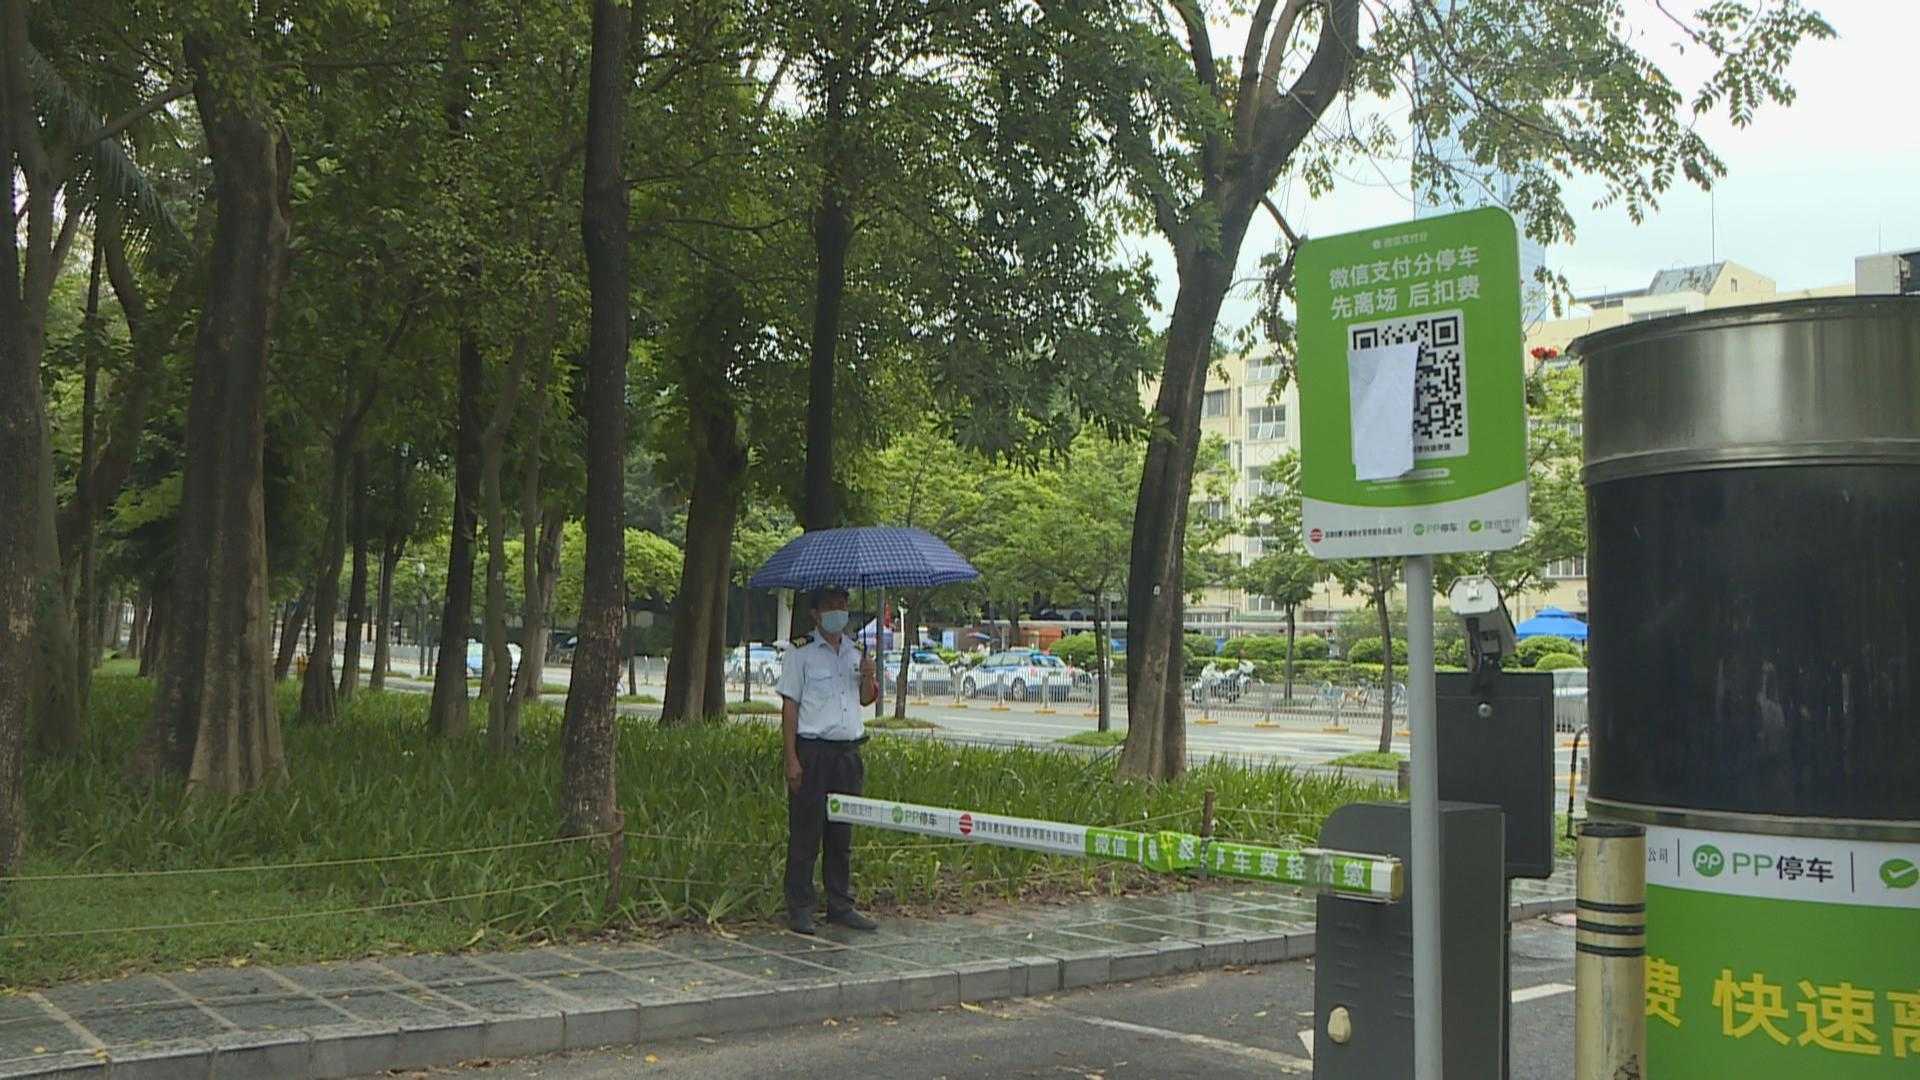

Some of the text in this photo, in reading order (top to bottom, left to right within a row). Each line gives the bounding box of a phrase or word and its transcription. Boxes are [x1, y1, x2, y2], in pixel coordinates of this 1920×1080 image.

[1329, 245, 1480, 290] 微信支付分停车
[1330, 274, 1481, 321] 先离场 后扣费
[905, 810, 938, 826] PP停车
[1095, 833, 1128, 857] 微信
[1732, 851, 1834, 883] PP停车
